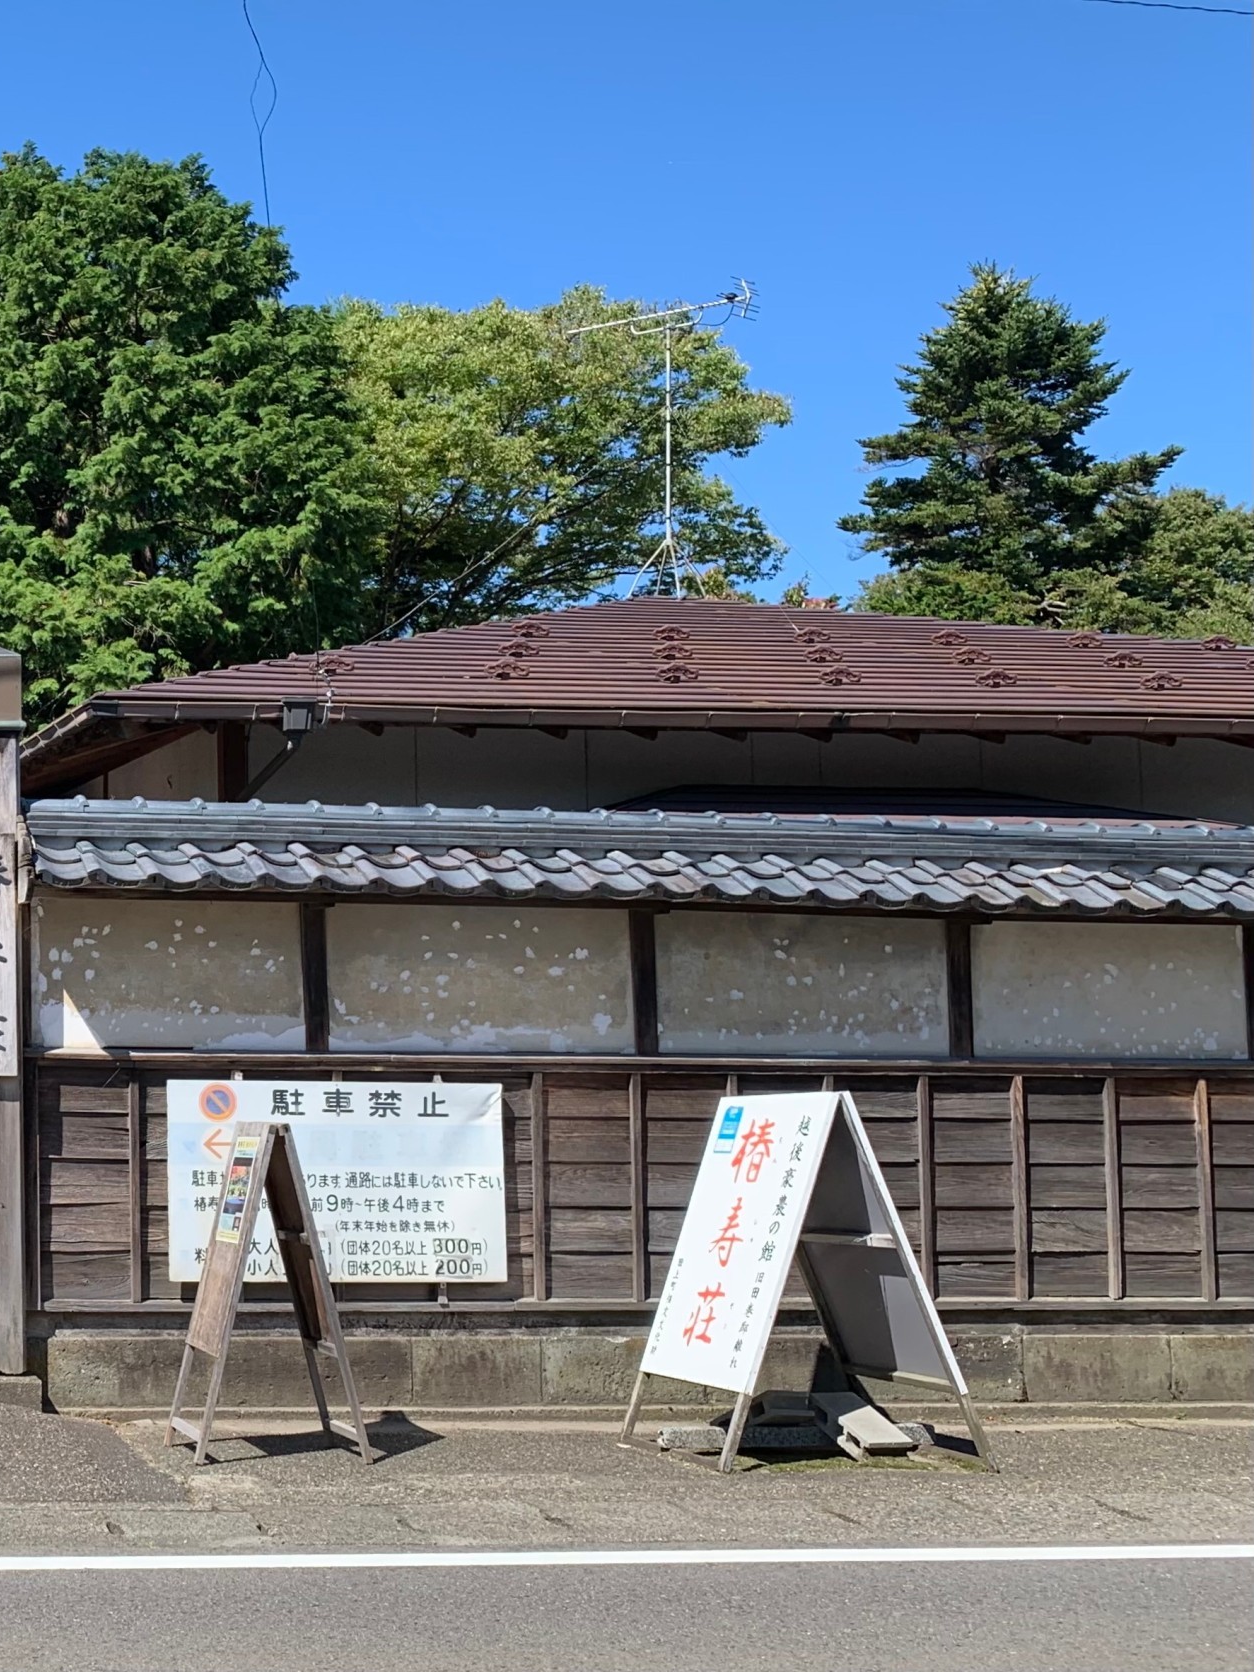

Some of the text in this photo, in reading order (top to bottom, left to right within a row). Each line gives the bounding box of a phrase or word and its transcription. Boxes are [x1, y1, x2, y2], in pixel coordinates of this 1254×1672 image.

[271, 1088, 450, 1118] 駐車禁止
[682, 1118, 776, 1347] 椿寿荘
